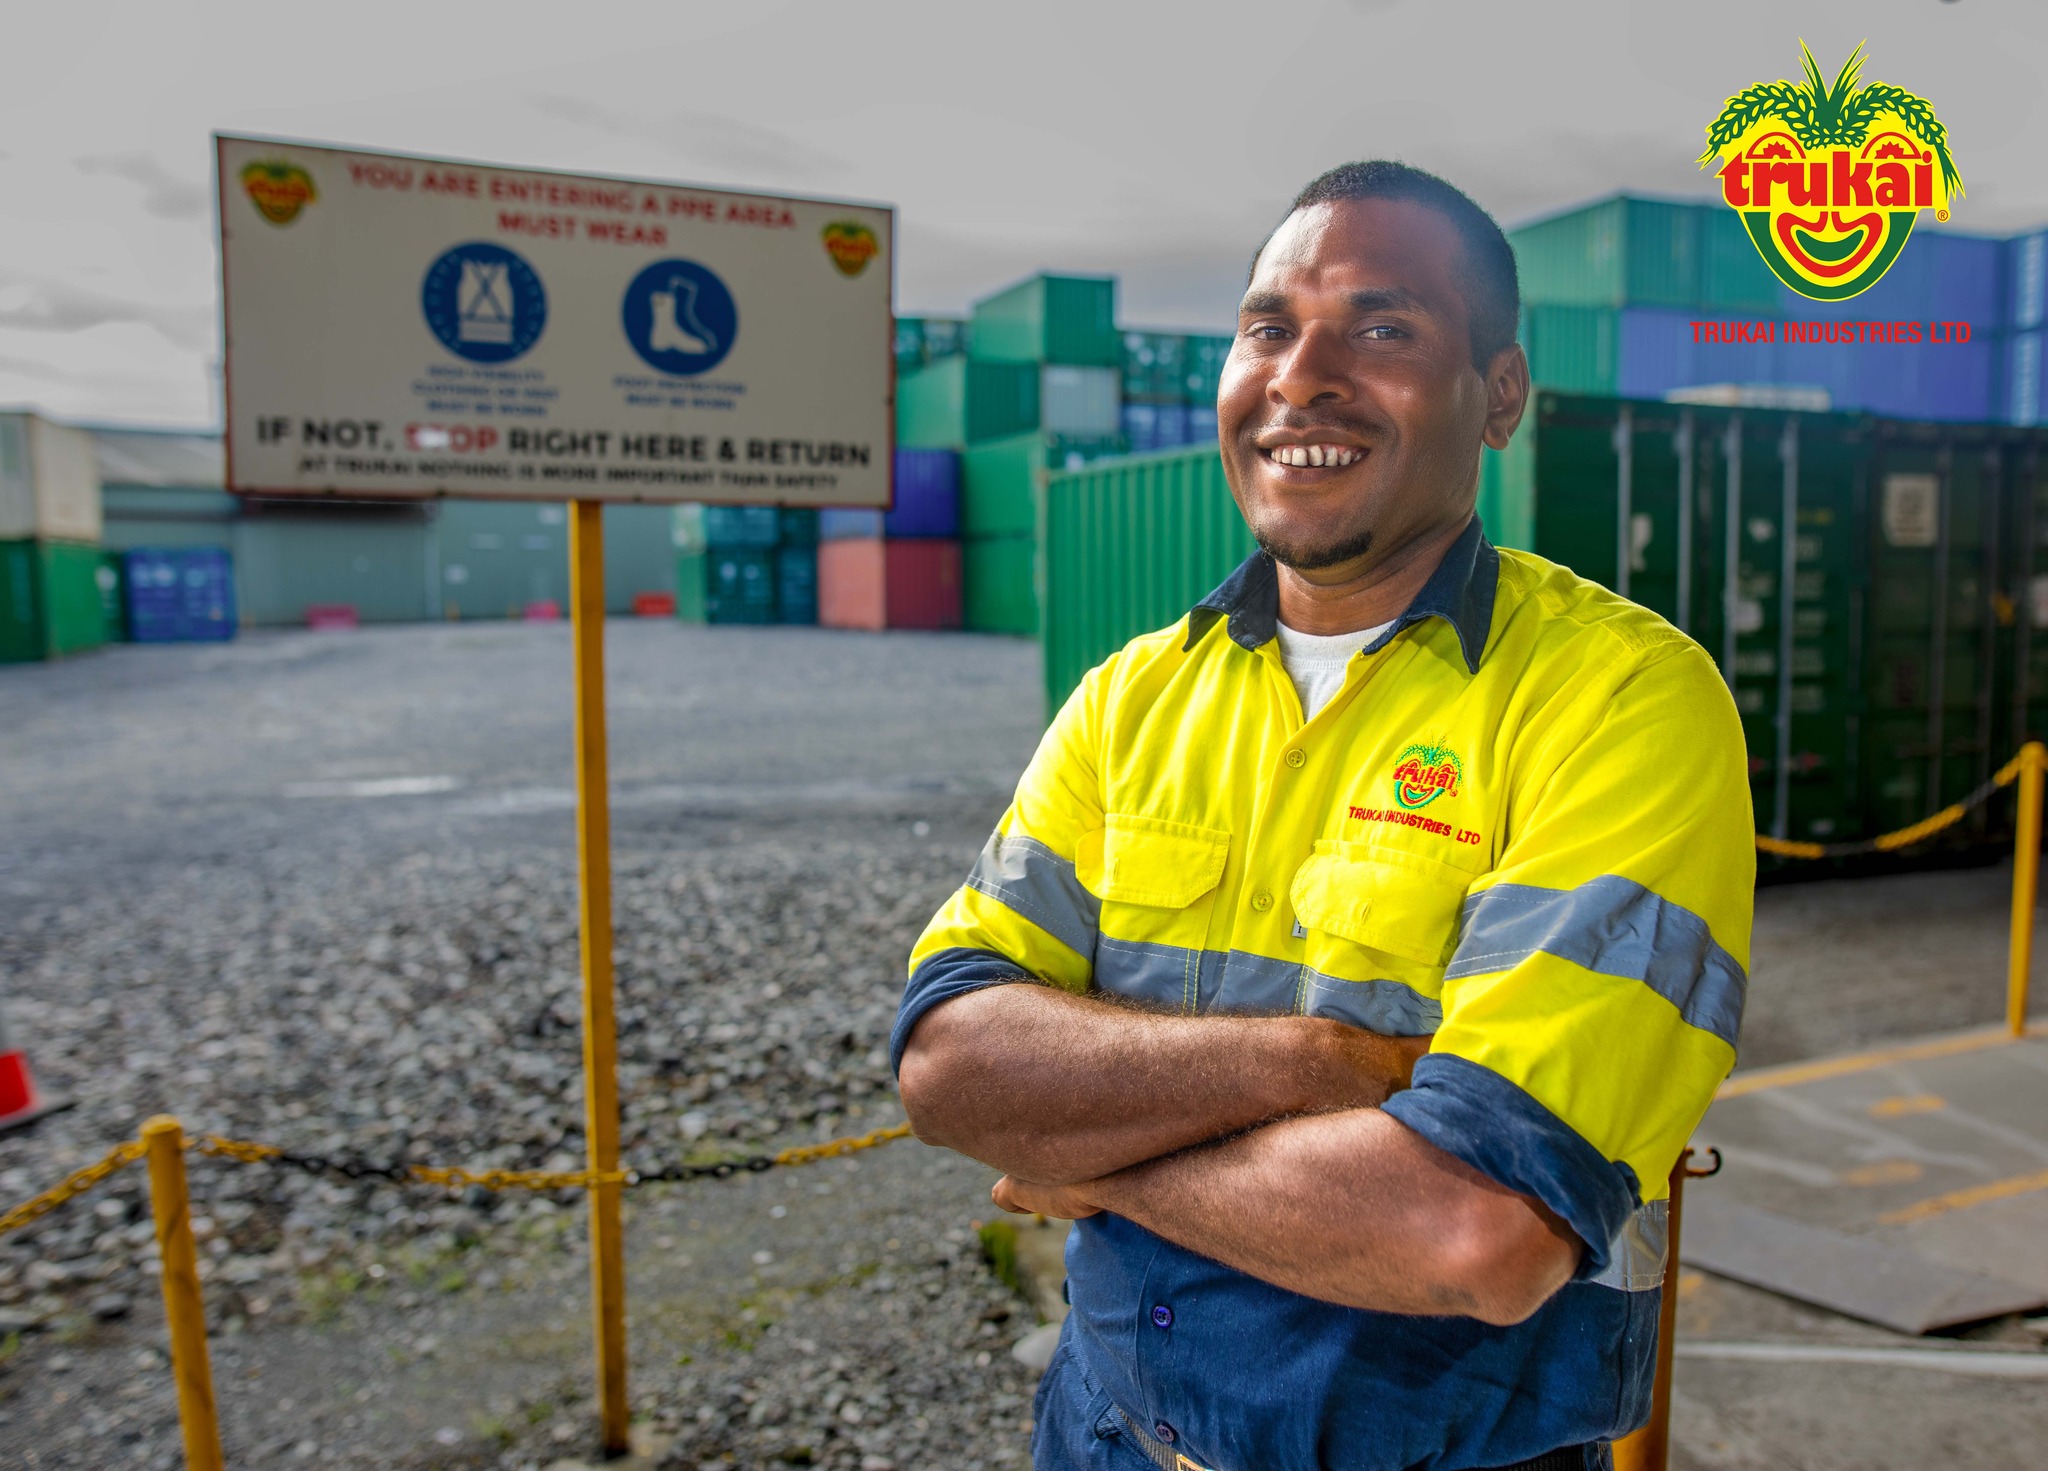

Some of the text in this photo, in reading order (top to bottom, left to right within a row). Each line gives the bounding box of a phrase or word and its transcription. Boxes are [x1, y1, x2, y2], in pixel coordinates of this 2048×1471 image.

[351, 163, 412, 189] YOU
[421, 170, 479, 195] ARE
[490, 174, 636, 213] ENTERING
[641, 195, 662, 213] A
[725, 202, 797, 228] AREA
[498, 210, 668, 246] MUST WEAR
[257, 415, 290, 444] IF
[509, 426, 609, 458] RIGHT
[622, 434, 710, 463] HERE
[718, 437, 736, 462] &
[746, 438, 870, 469] RETURN
[1384, 810, 1452, 836] INDUSTRIES
[1456, 829, 1481, 845] LTD
